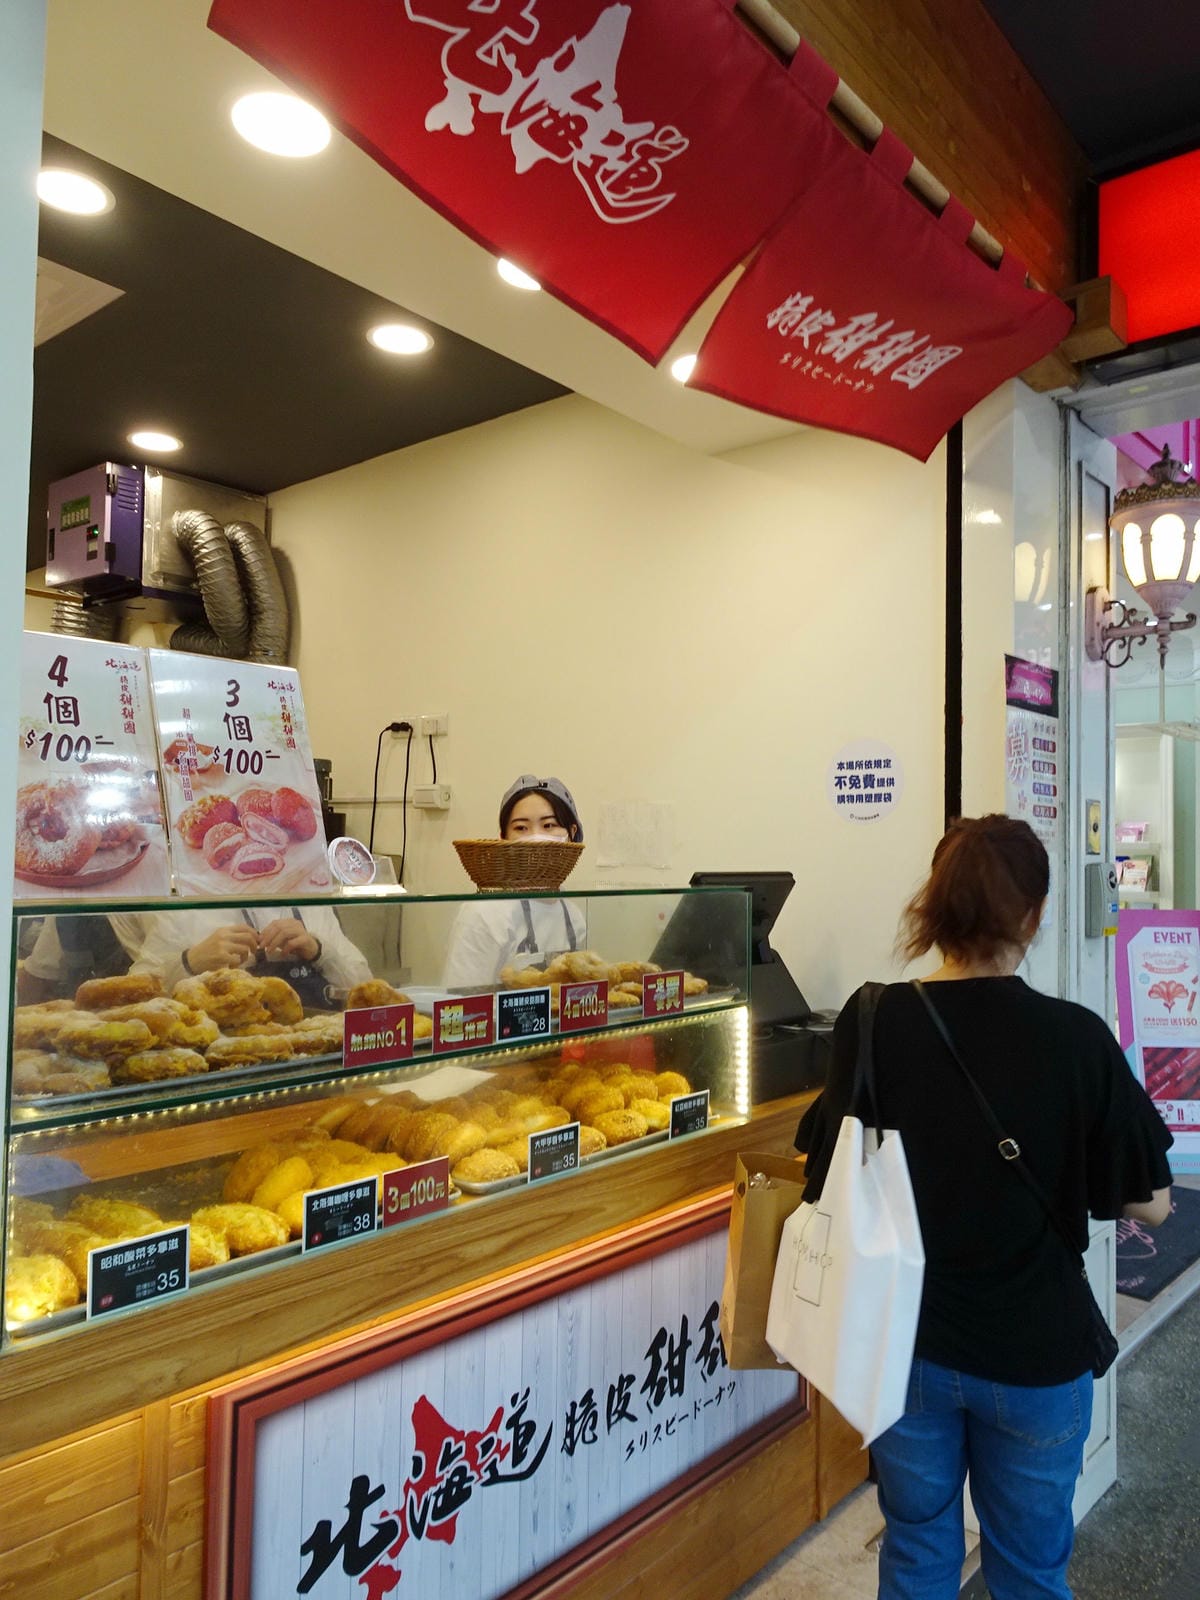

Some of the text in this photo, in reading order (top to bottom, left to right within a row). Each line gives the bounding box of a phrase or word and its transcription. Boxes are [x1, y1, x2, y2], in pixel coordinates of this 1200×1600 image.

[836, 758, 893, 772] 本場所依規定
[834, 773, 896, 790] 不免費提供
[836, 792, 893, 805] 購物用塑膠袋
[1153, 931, 1193, 945] EVENT
[563, 992, 606, 1020] 4個100元
[532, 1017, 546, 1033] 28
[695, 1117, 705, 1131] 35
[562, 1152, 575, 1169] 35
[387, 1175, 445, 1214] 3個100元
[353, 1213, 371, 1232] 38
[156, 1268, 180, 1291] 35
